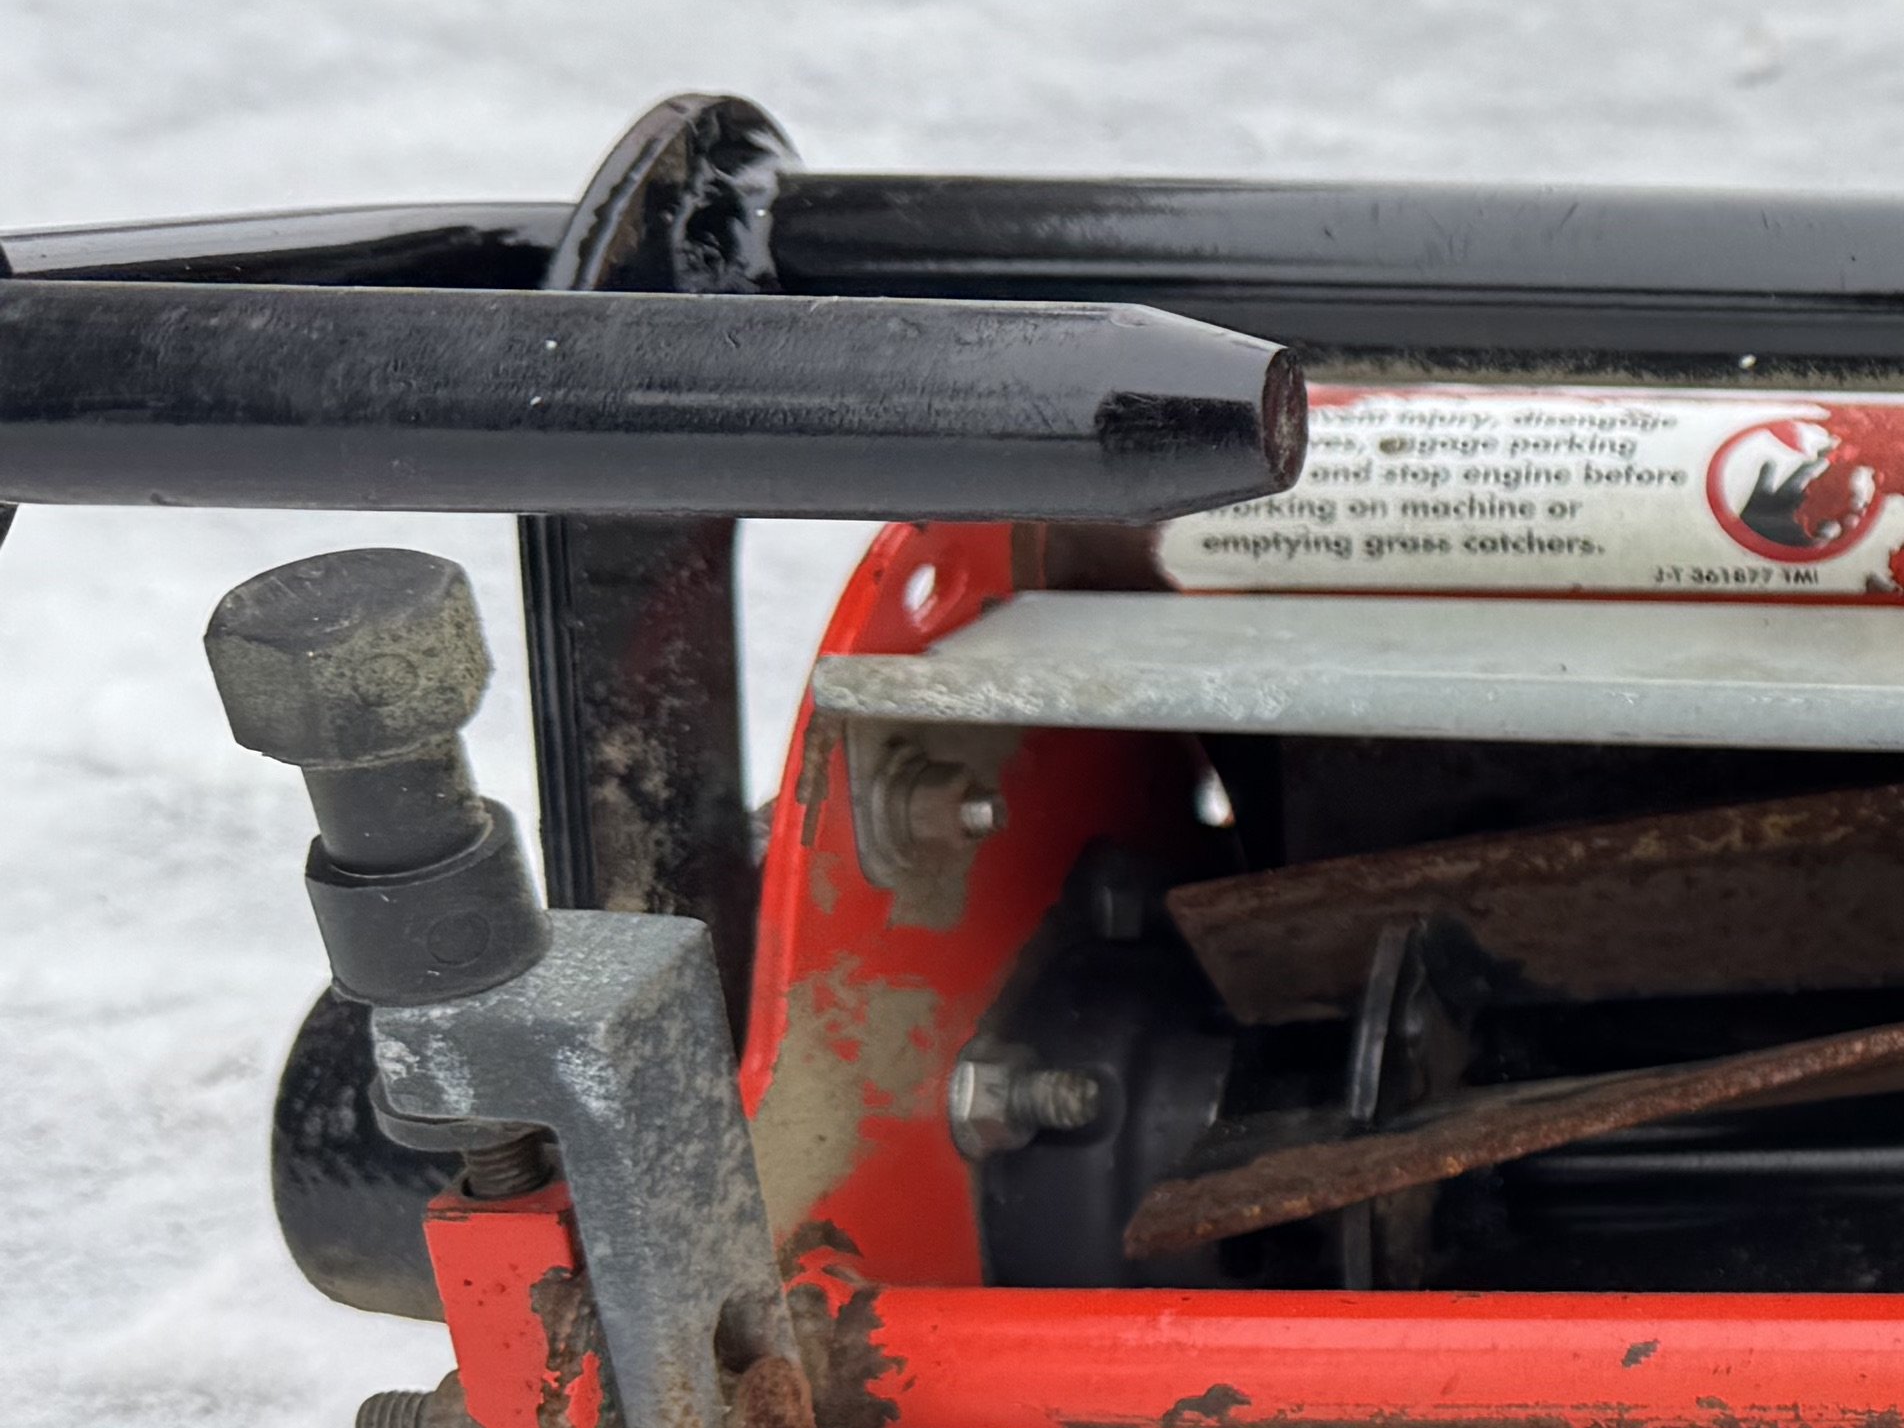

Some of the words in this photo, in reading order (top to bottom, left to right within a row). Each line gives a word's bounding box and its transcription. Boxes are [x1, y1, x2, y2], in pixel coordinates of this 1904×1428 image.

[1510, 433, 1637, 458] parking
[1310, 459, 1372, 482] and
[1385, 466, 1450, 488] stop
[1463, 460, 1571, 490] engine
[1584, 461, 1688, 485] before
[1349, 500, 1387, 518] on
[1401, 494, 1536, 519] machine
[1548, 500, 1582, 518] or
[1202, 527, 1353, 560] emptying
[1364, 534, 1451, 559] grass
[1464, 528, 1605, 555] catchers.
